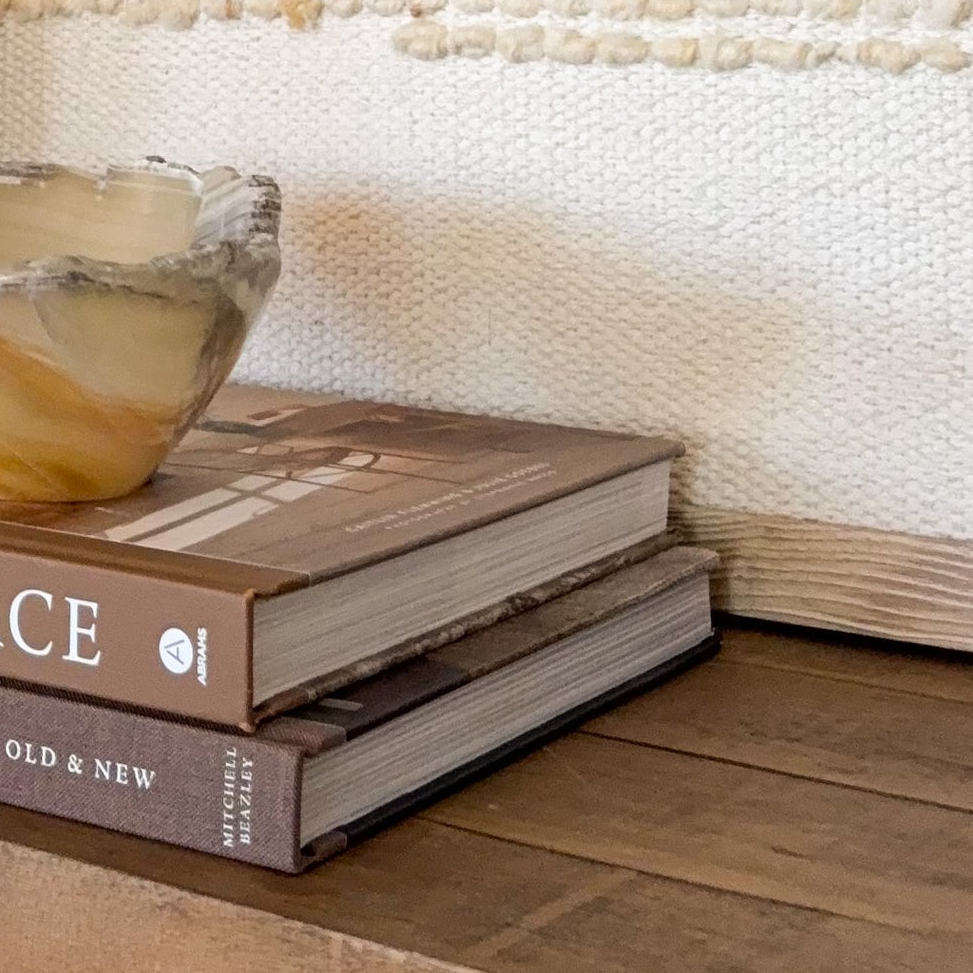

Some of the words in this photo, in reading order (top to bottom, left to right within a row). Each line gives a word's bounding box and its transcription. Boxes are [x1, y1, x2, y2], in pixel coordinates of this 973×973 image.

[196, 627, 208, 686] ABRAMS
[5, 739, 57, 767] OLD
[67, 754, 84, 775] &
[94, 758, 156, 789] NEW
[222, 746, 237, 848] MITCHELL
[239, 757, 253, 845] BEAZLEY
